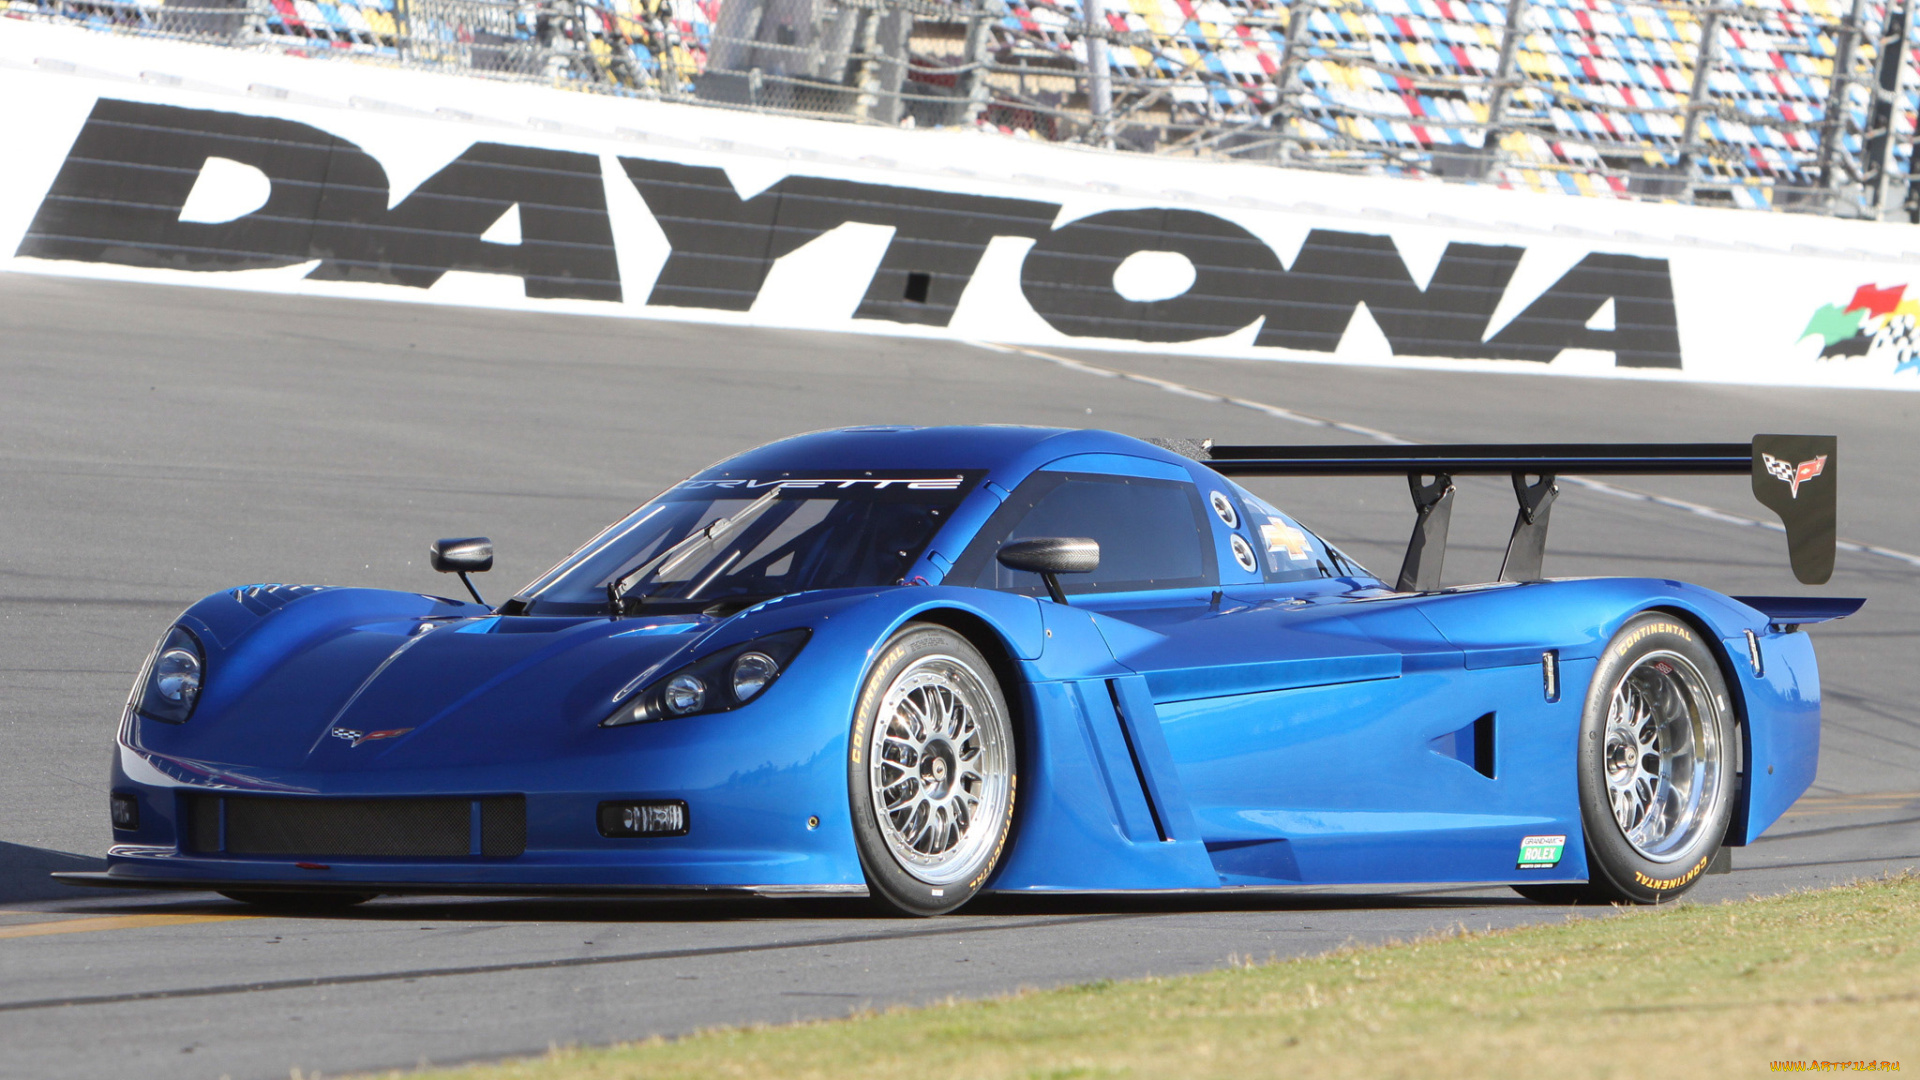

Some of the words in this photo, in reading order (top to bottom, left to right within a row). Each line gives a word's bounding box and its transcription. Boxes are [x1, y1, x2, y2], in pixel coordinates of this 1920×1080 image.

[14, 97, 1683, 370] DAYTONA
[1619, 622, 1692, 656] CONTINENTAL
[851, 646, 905, 764] CONTINENTAL
[1524, 846, 1556, 861] ROLEX
[1635, 856, 1708, 890] CONTINENTAL
